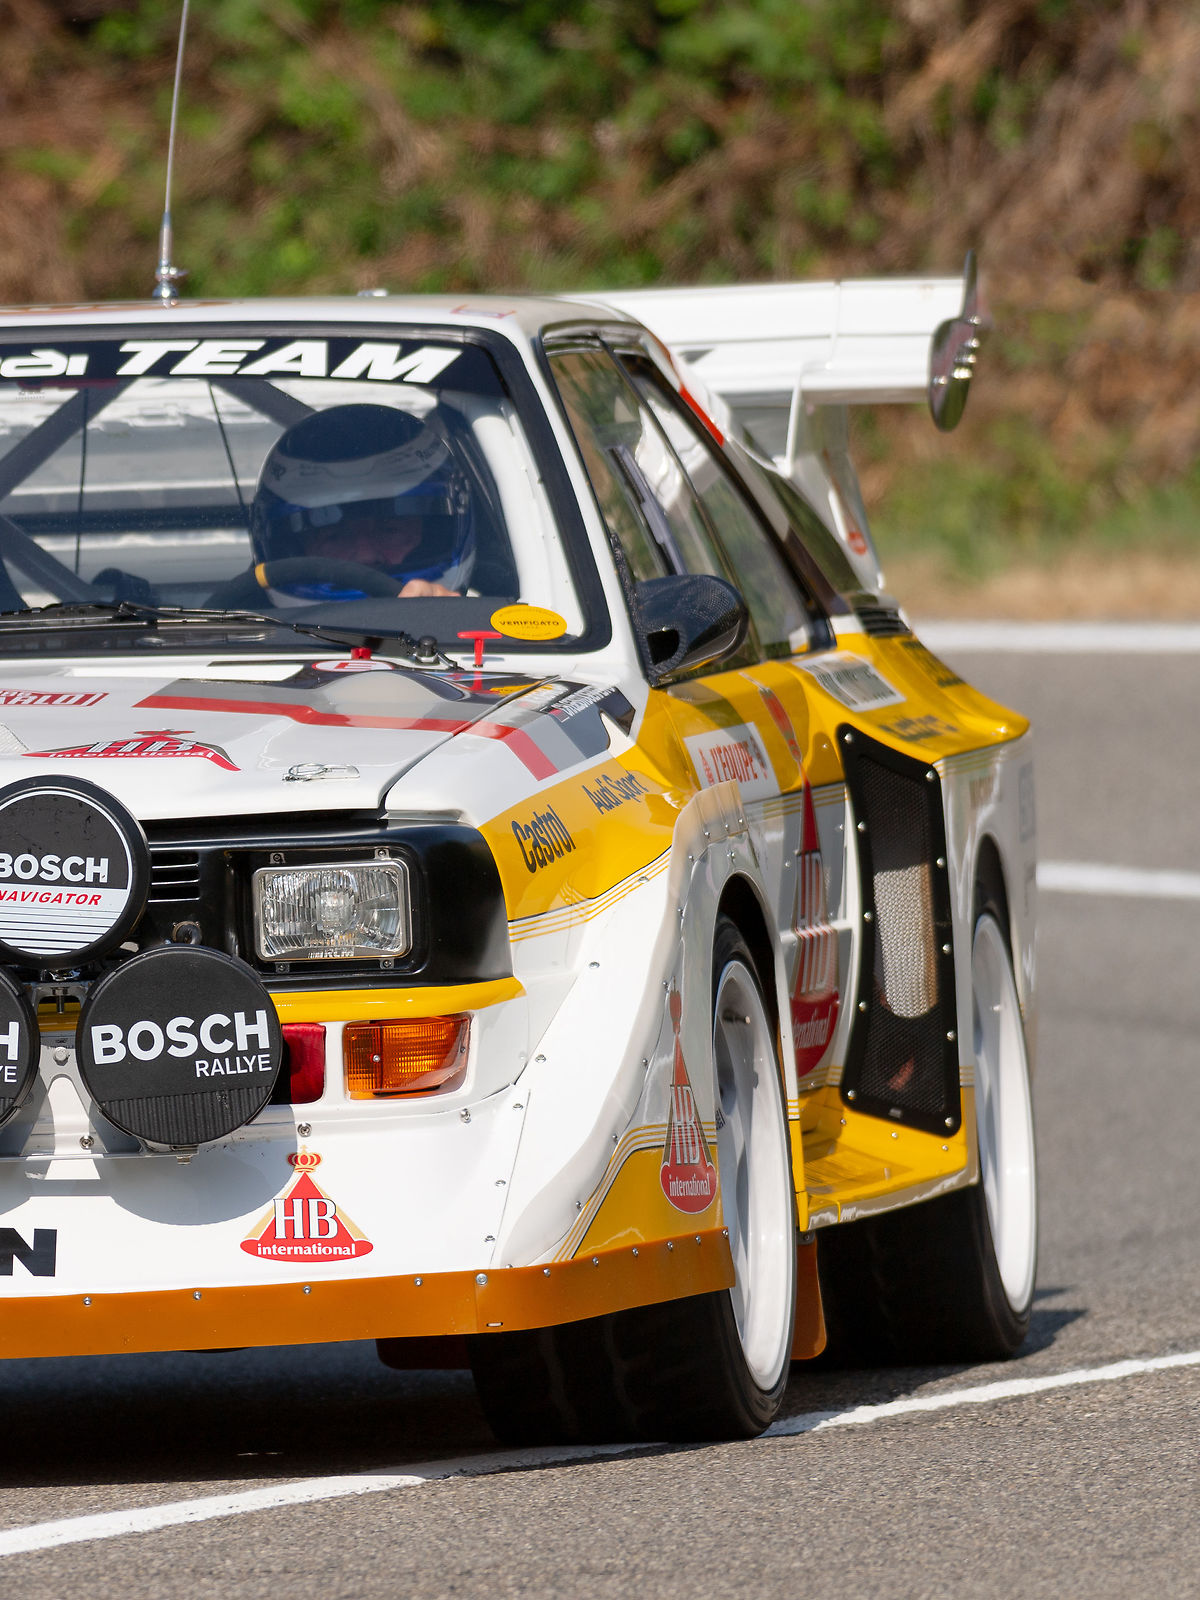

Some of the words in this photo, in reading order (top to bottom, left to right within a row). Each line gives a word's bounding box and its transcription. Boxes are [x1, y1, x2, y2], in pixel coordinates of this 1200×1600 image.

[116, 339, 463, 384] TEAM
[499, 619, 560, 627] VERIFICATO
[85, 741, 198, 753] HB
[582, 777, 623, 815] Audi
[601, 769, 650, 803] Sport
[511, 804, 576, 874] Castrol
[91, 1009, 270, 1065] BOSCH
[195, 1053, 273, 1078] RALLYE
[668, 1172, 712, 1197] international
[272, 1197, 339, 1240] HB
[256, 1239, 357, 1257] international
